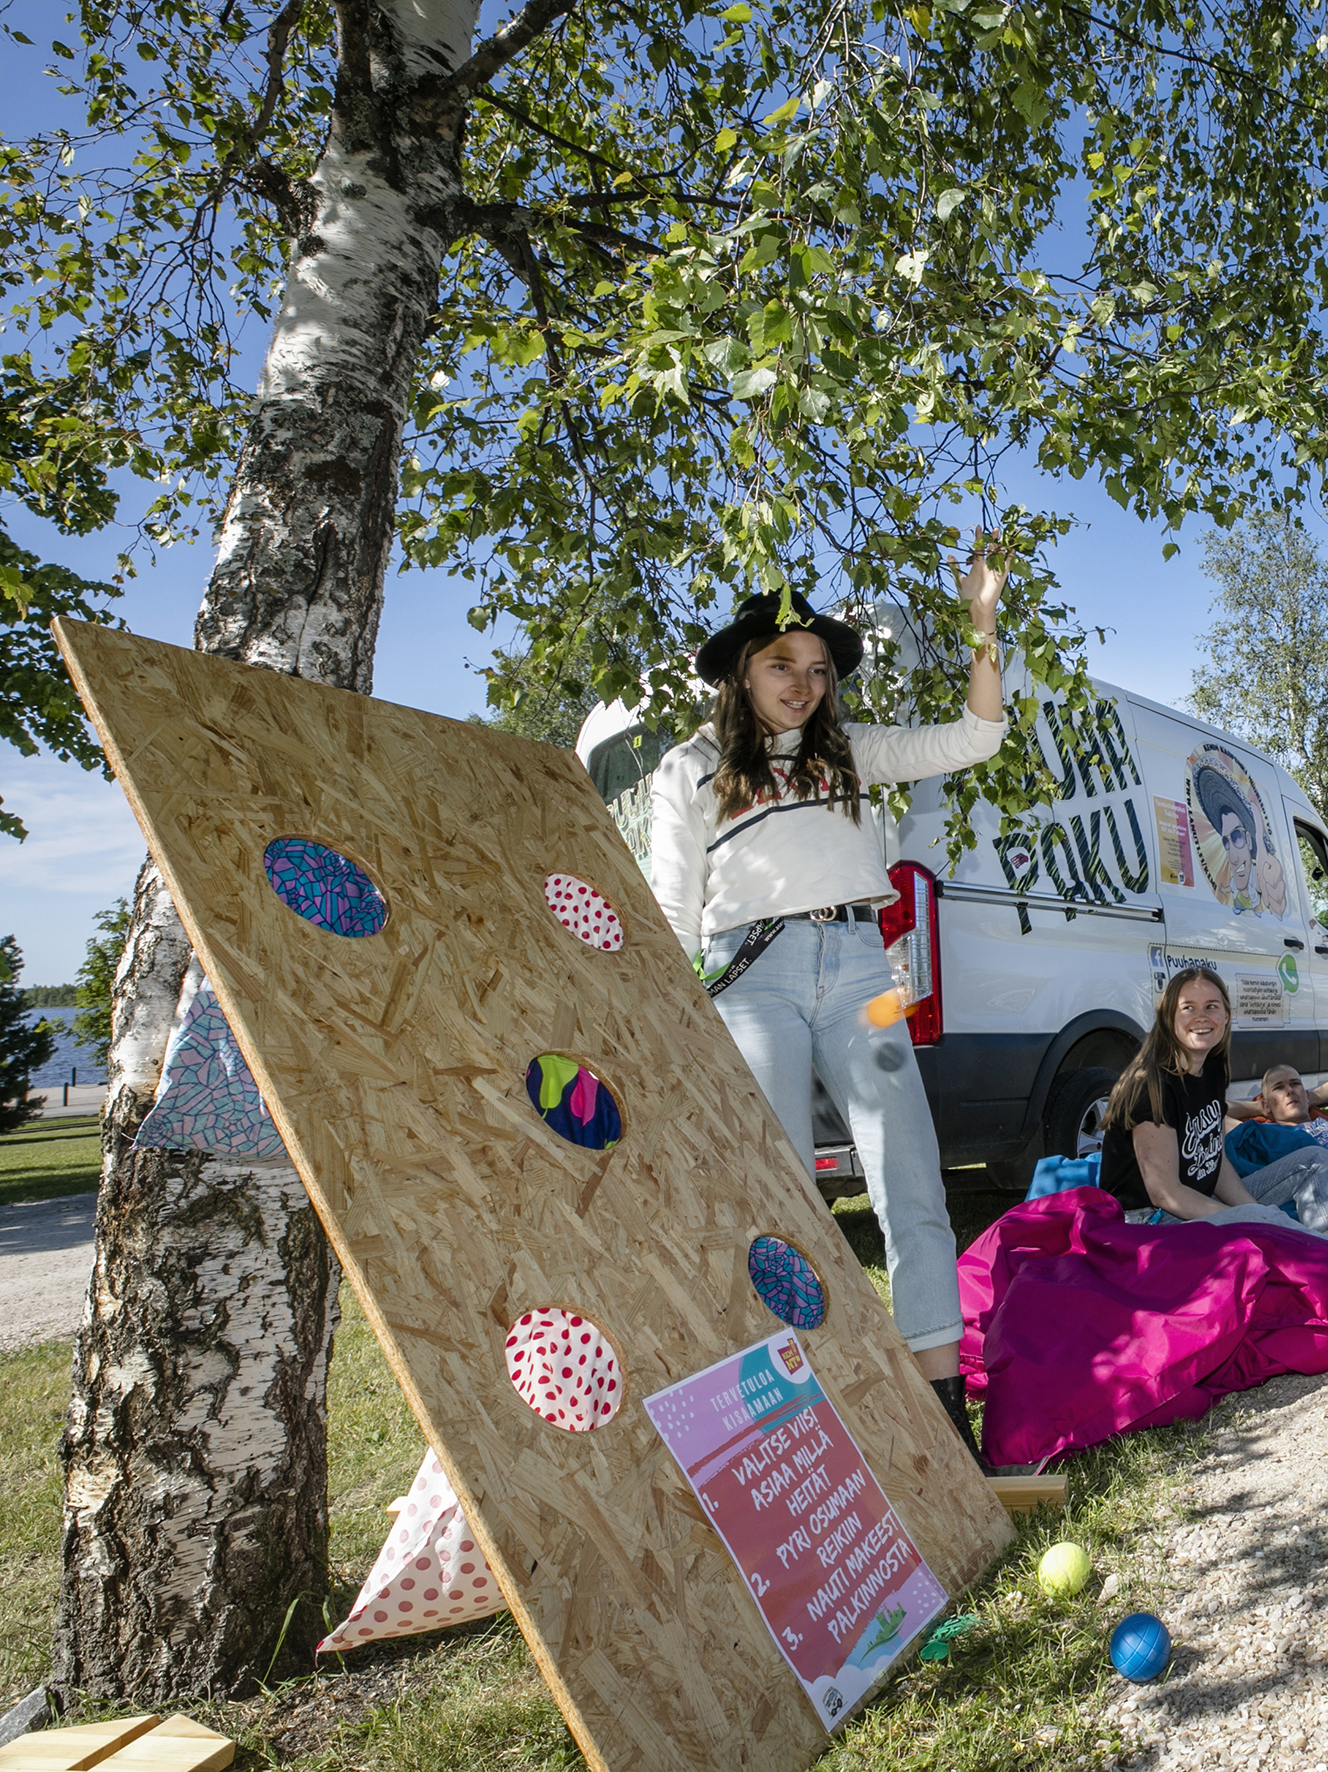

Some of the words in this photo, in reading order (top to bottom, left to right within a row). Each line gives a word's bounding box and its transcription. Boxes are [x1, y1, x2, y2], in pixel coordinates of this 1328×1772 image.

[992, 798, 1150, 936] PAKU
[746, 920, 765, 946] APSET
[724, 957, 751, 985] LAPSET
[1166, 955, 1218, 971] Puuhapaku
[710, 1368, 775, 1413] TERVETULOA
[722, 1387, 784, 1431] KISAAMAAN
[703, 1492, 719, 1512] 1.
[731, 1427, 792, 1486] VALITSE
[786, 1405, 819, 1439] VIISI
[750, 1462, 798, 1511] ASIAA
[792, 1424, 834, 1474] MILLÄ
[785, 1463, 832, 1517] HEITÄT
[751, 1573, 771, 1598] 2.
[776, 1525, 812, 1570] PYRI
[809, 1468, 867, 1535] OSUMAAN
[816, 1511, 863, 1569] REIKIIN
[781, 1626, 804, 1651] 3.
[806, 1566, 850, 1622] NAUTI
[826, 1538, 914, 1644] PALKINNOSTA
